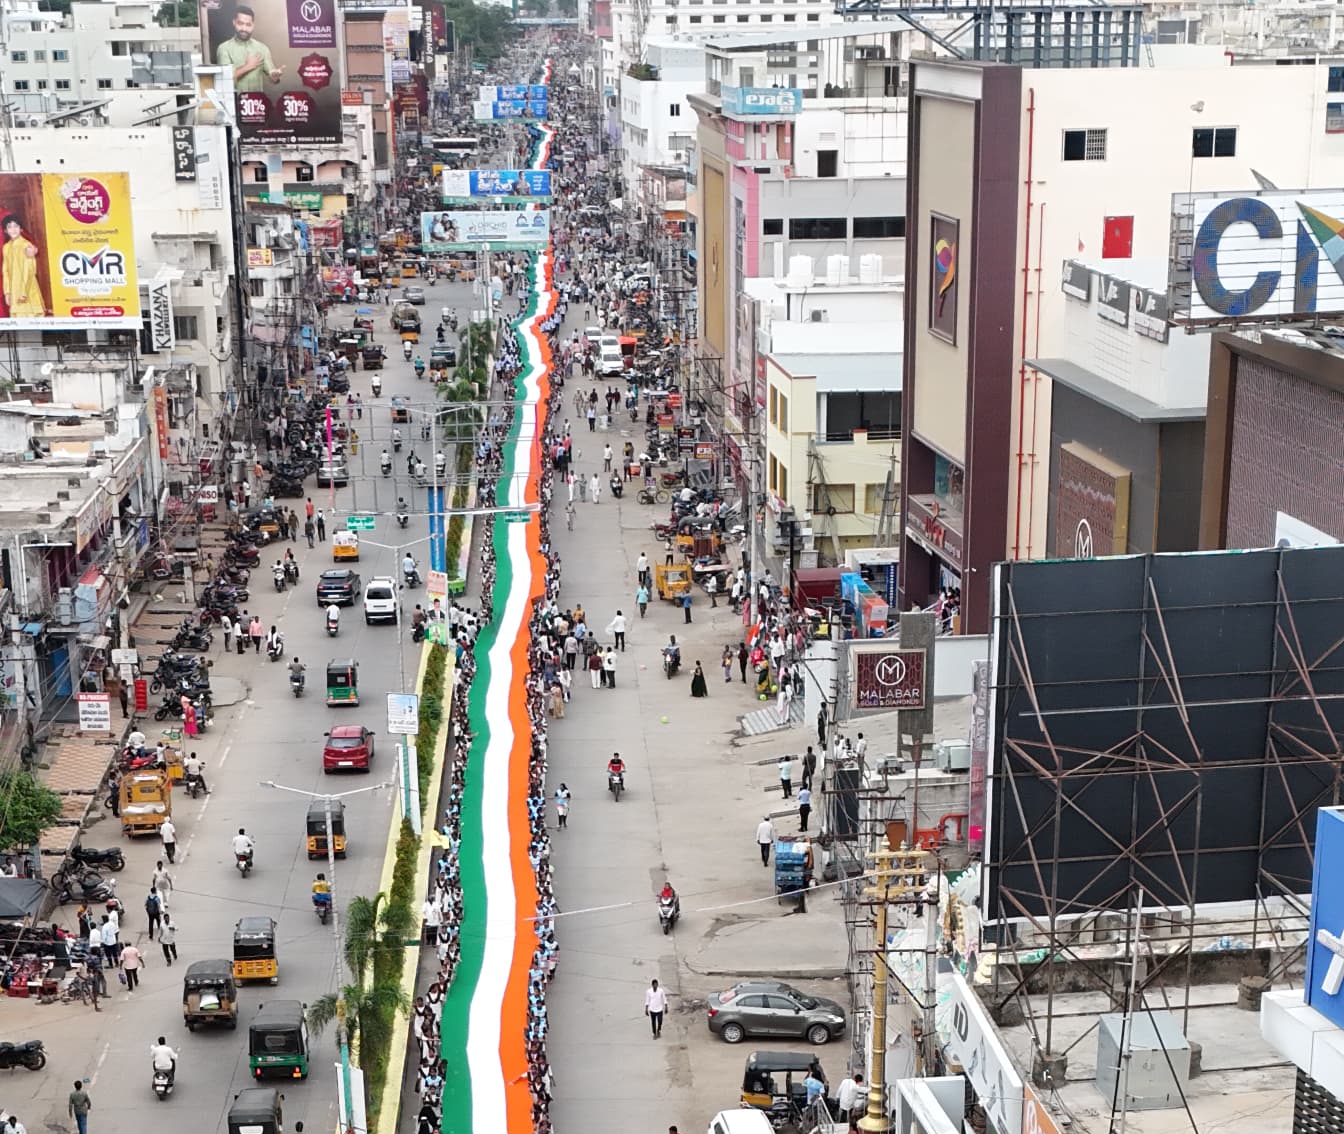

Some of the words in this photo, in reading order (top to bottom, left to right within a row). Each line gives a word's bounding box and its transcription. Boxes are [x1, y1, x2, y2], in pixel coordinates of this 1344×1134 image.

[62, 246, 124, 276] CMR
[153, 283, 171, 350] KHAZANA
[860, 688, 920, 699] MALABAR
